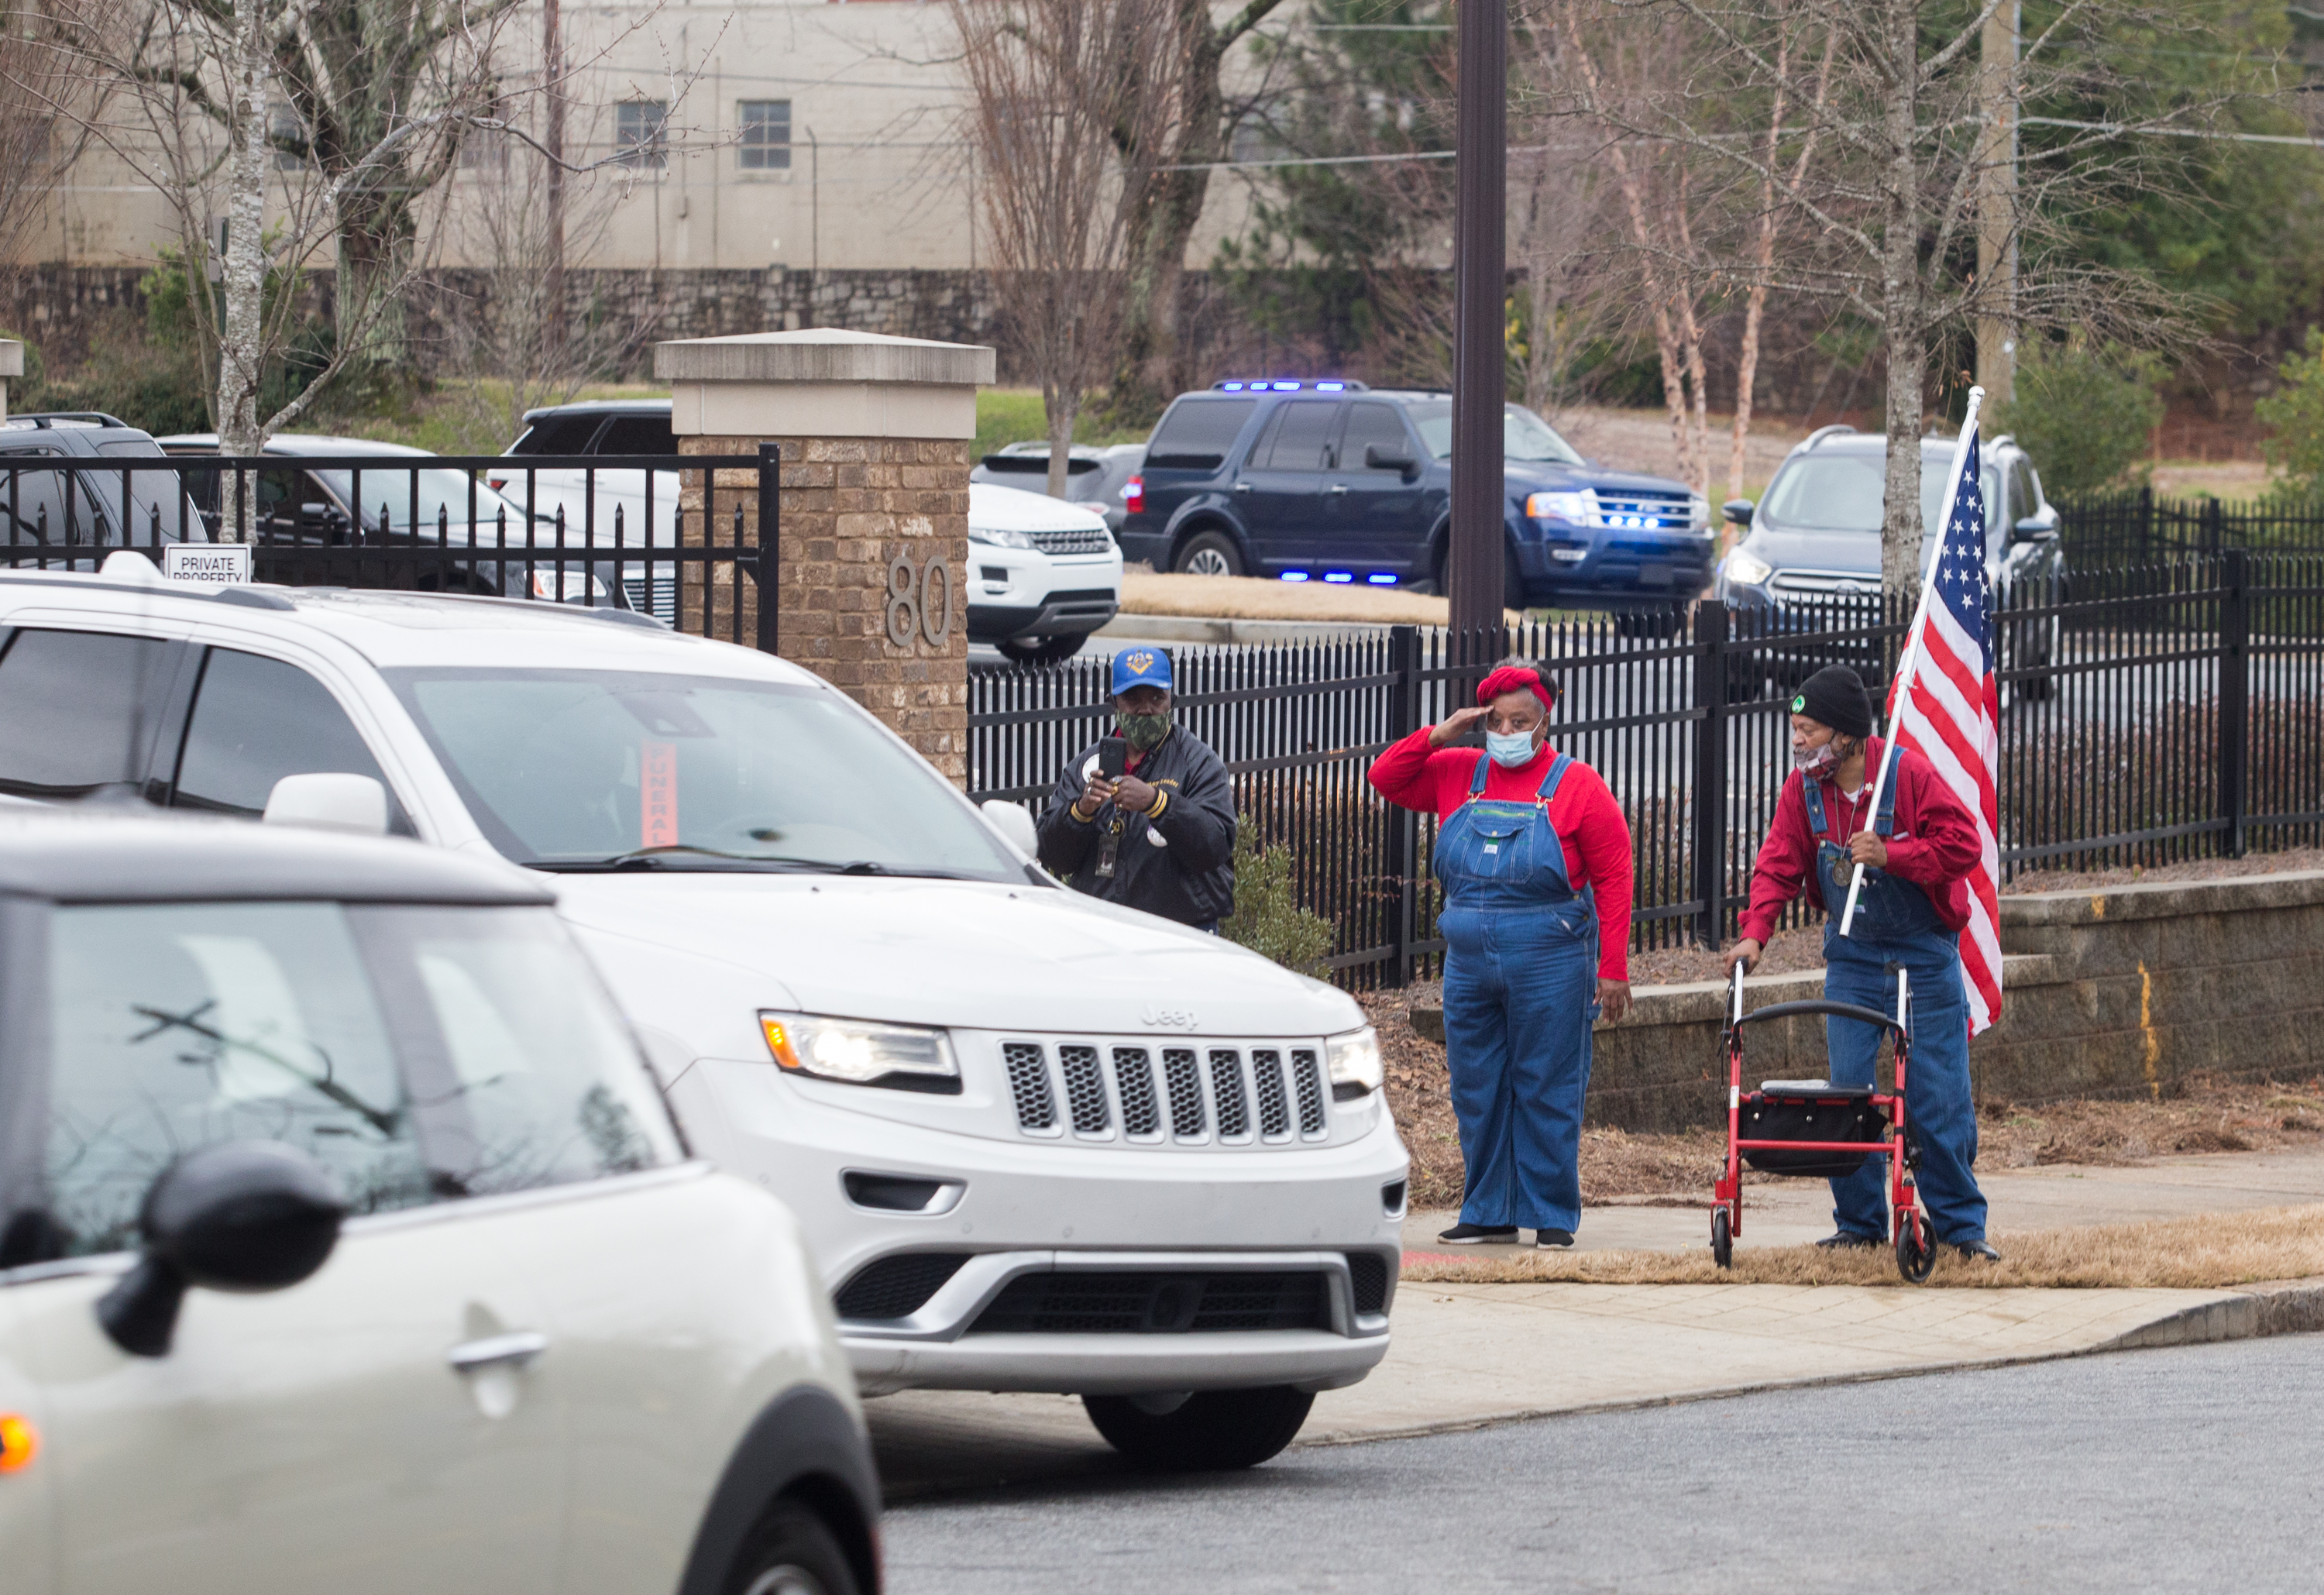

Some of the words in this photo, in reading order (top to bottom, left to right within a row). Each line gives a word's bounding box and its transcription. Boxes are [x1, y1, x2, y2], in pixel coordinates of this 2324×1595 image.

[181, 557, 235, 571] PRIVATE
[887, 555, 952, 646] 80
[649, 748, 667, 844] FUNERAL
[1140, 1005, 1199, 1031] Jeep
